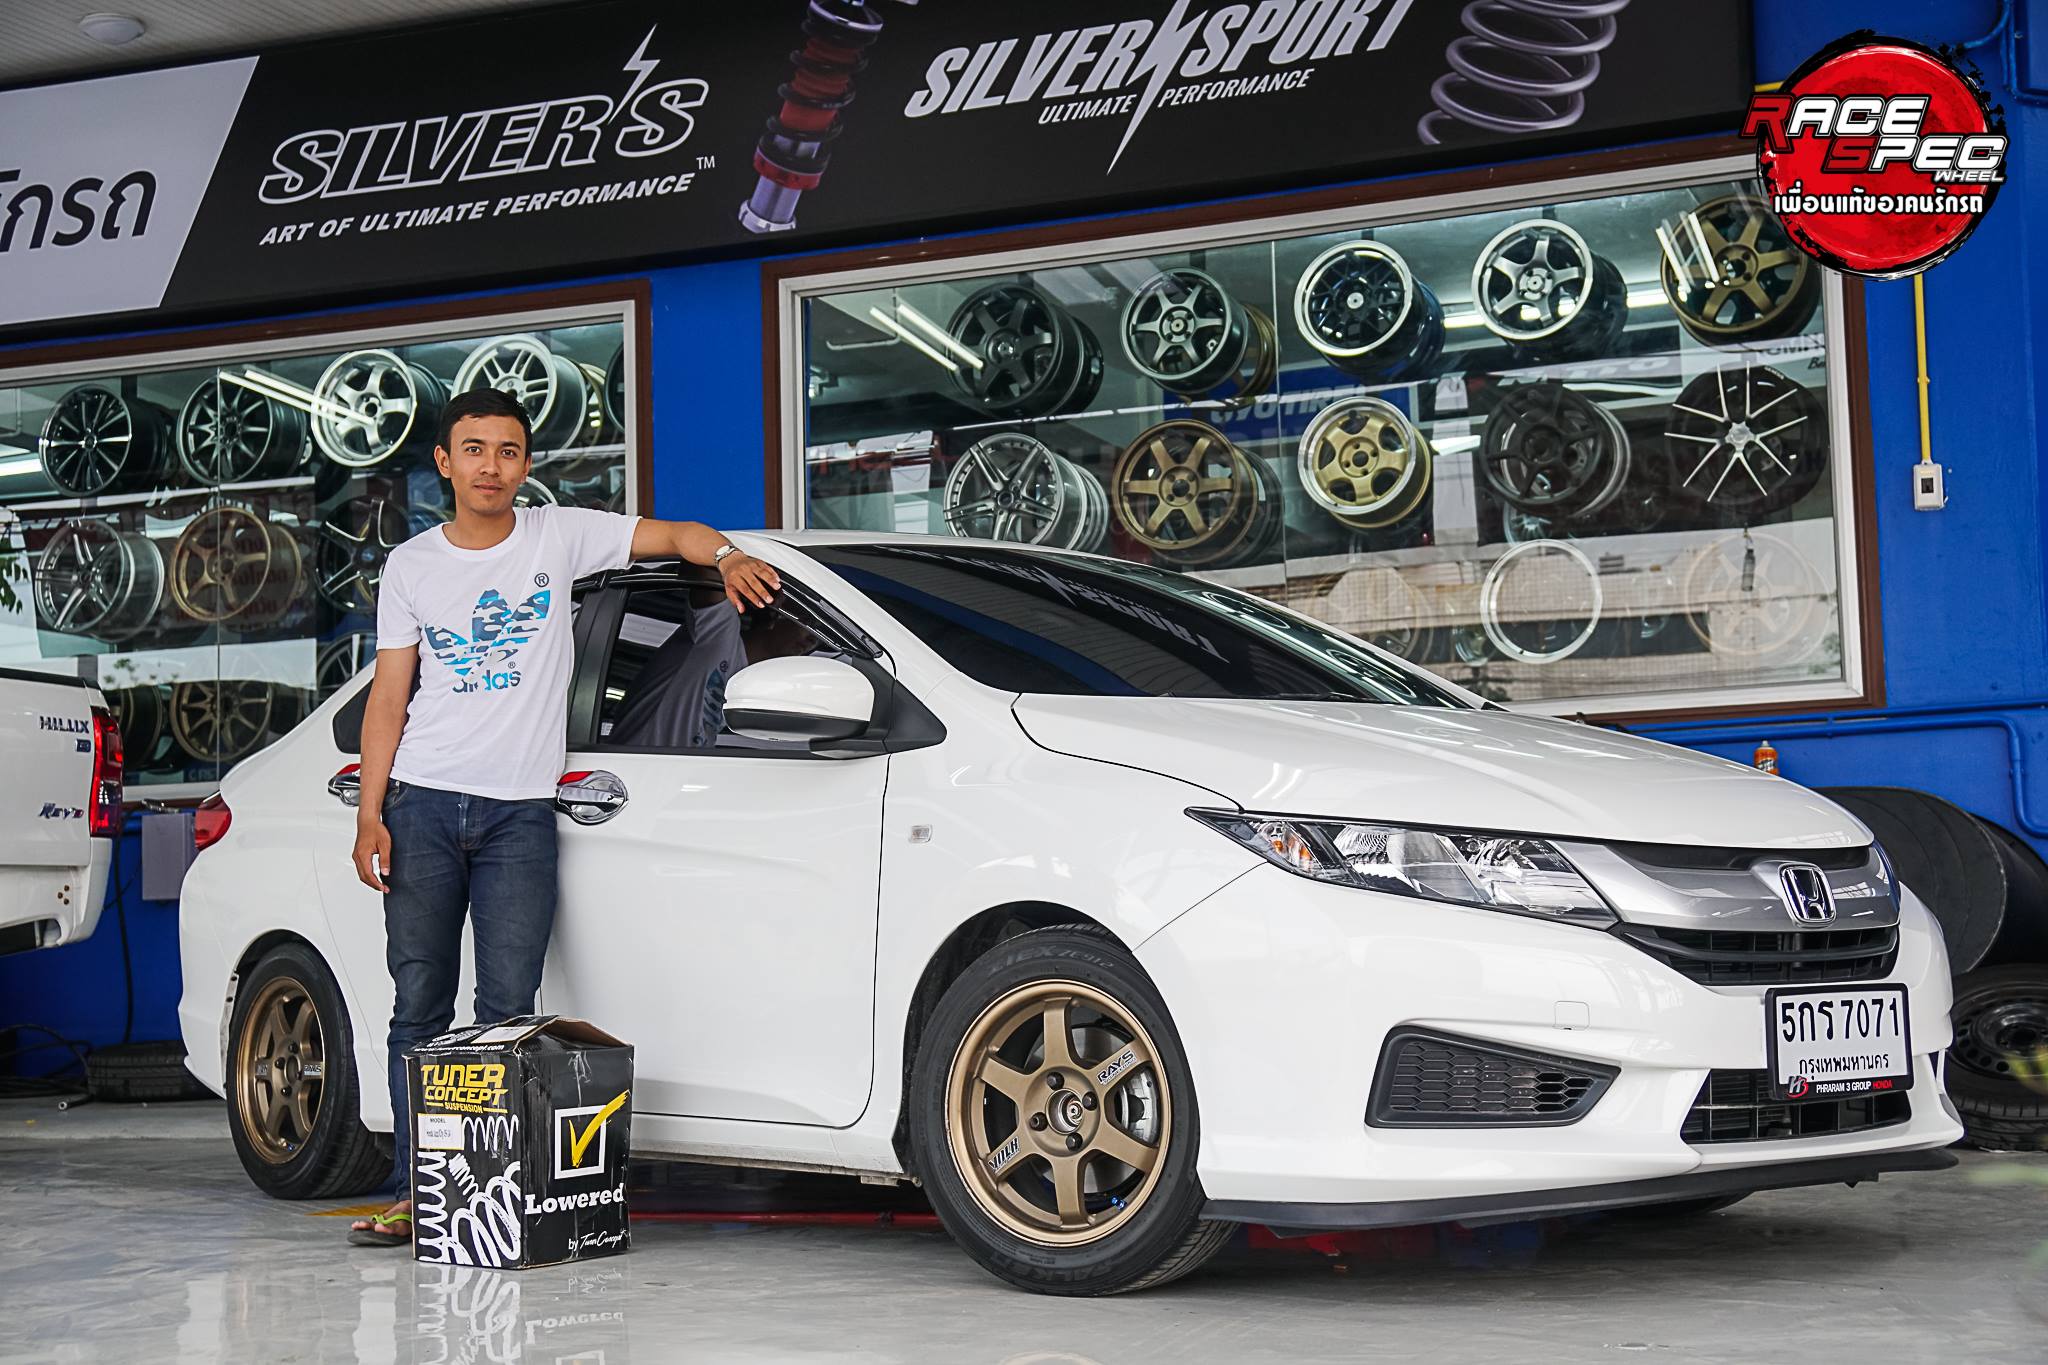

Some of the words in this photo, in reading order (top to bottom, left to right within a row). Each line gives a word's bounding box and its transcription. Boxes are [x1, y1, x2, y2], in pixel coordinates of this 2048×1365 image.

[904, 19, 1154, 118] SILVER
[1038, 94, 1137, 124] ULTIMATE
[1157, 68, 1315, 108] PERFORMANCE
[259, 222, 312, 245] ART
[318, 217, 353, 238] OF
[360, 200, 489, 232] ULTIMATE
[494, 172, 695, 216] PERFORMANCE
[1781, 1000, 1834, 1042] 5กร
[1841, 997, 1899, 1039] 7071
[421, 1064, 505, 1088] TUNER
[1098, 1050, 1134, 1082] RAYS
[1799, 1054, 1889, 1080] กรุงเทพมหานคร
[425, 1086, 508, 1105] CONCEPT
[1816, 1082, 1845, 1093] PHRARAM
[1846, 1082, 1851, 1091] 3
[1851, 1081, 1872, 1091] GROUP
[1872, 1080, 1892, 1089] HONDA
[445, 1102, 483, 1113] SUSPENSION
[525, 1183, 624, 1214] Lowered
[568, 1239, 579, 1251] by
